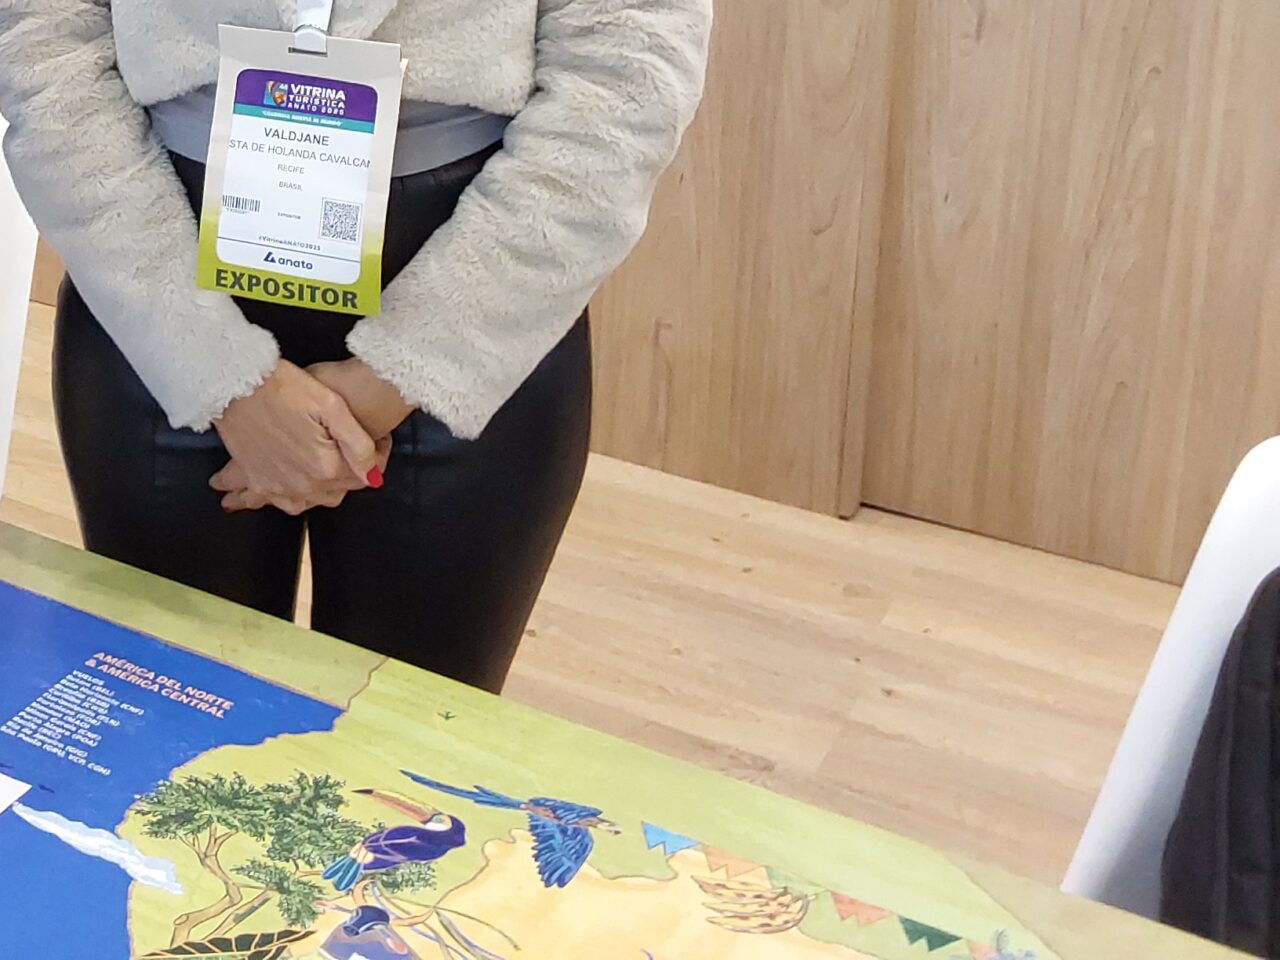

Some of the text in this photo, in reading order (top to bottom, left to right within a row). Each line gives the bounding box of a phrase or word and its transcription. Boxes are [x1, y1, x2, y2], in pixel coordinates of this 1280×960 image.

[290, 83, 346, 100] VITRINA
[264, 127, 330, 146] VALDJANE
[251, 142, 265, 152] DE
[268, 144, 317, 160] HOLANDA
[277, 163, 305, 175] RECIFE
[278, 181, 303, 191] BRASIL
[278, 257, 313, 270] anato
[215, 268, 359, 309] EXPOSITOR
[155, 675, 182, 690] DEL
[184, 687, 234, 710] NORTE
[161, 689, 224, 719] CENTRAL
